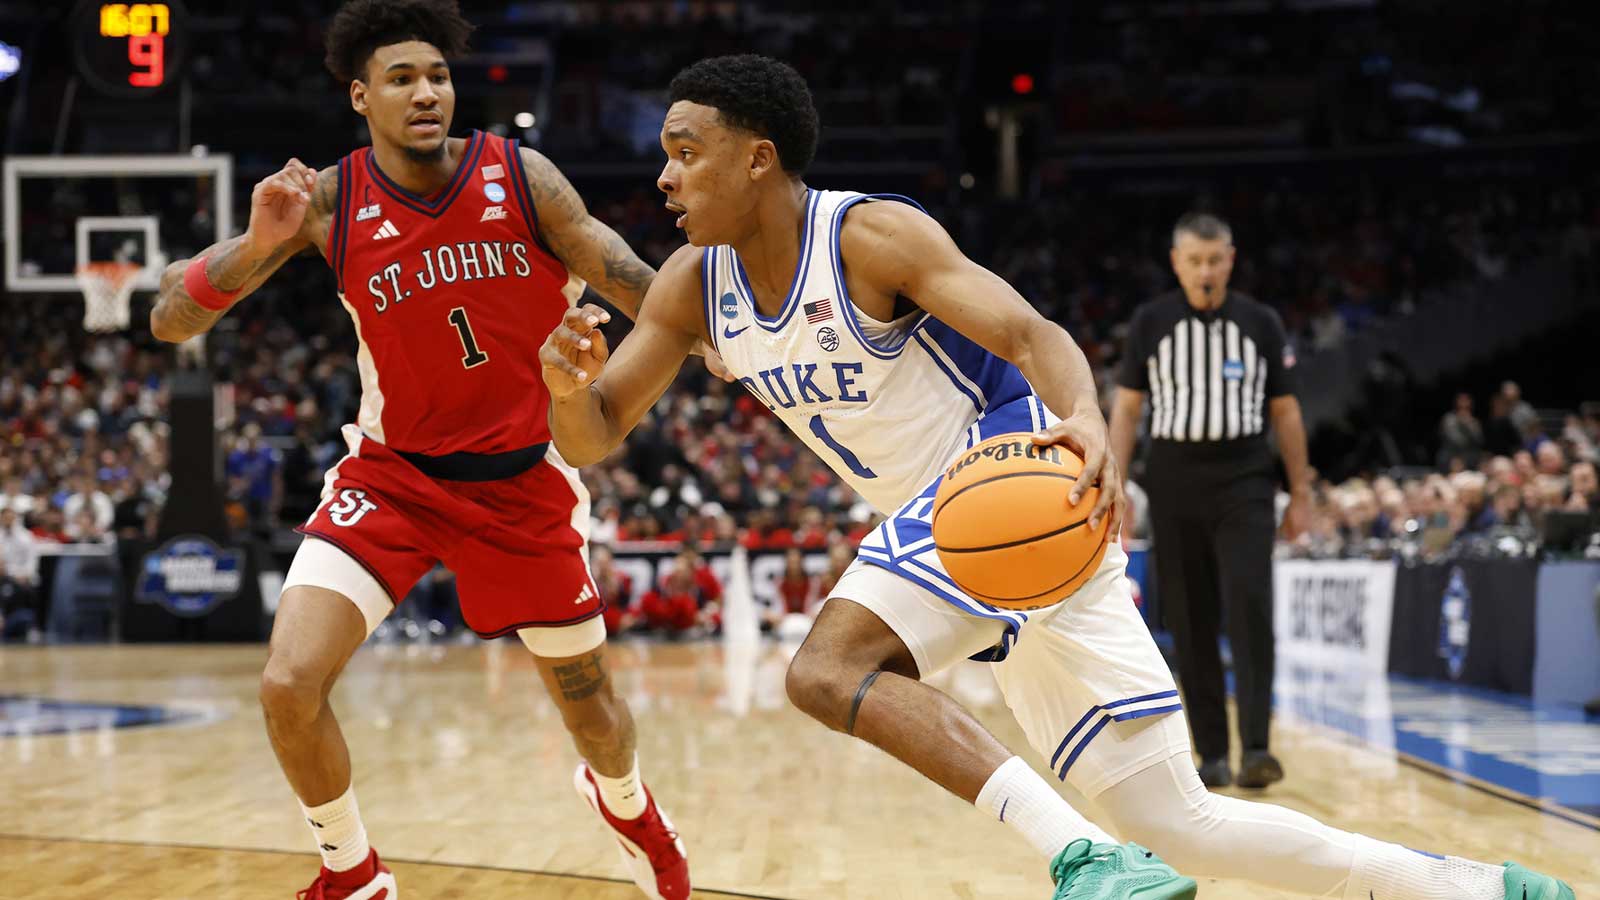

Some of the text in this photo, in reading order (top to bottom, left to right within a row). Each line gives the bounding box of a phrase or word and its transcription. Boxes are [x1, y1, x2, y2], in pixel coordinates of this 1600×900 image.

[128, 33, 164, 87] 9
[367, 241, 532, 313] ST. JOHN'S
[448, 306, 489, 370] 1
[808, 414, 879, 480] 1
